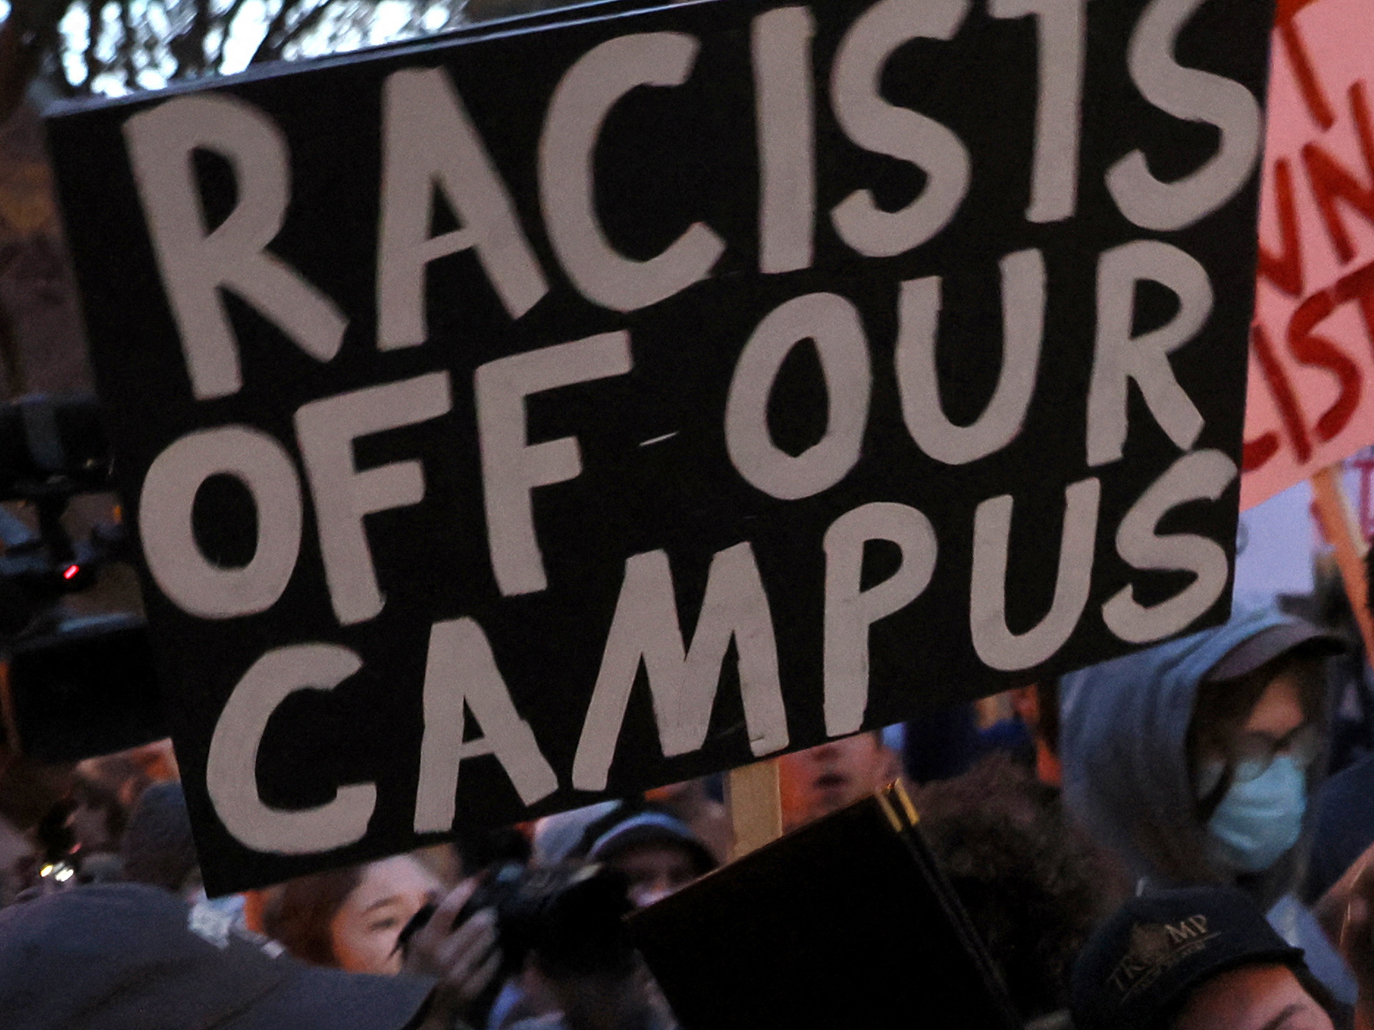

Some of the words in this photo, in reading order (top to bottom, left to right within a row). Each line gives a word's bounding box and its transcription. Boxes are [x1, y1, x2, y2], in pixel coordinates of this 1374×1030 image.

[122, 0, 1263, 401] RACISTS
[138, 329, 634, 626] OFF
[724, 238, 1214, 502] OUR
[205, 448, 1240, 856] CAMPUS
